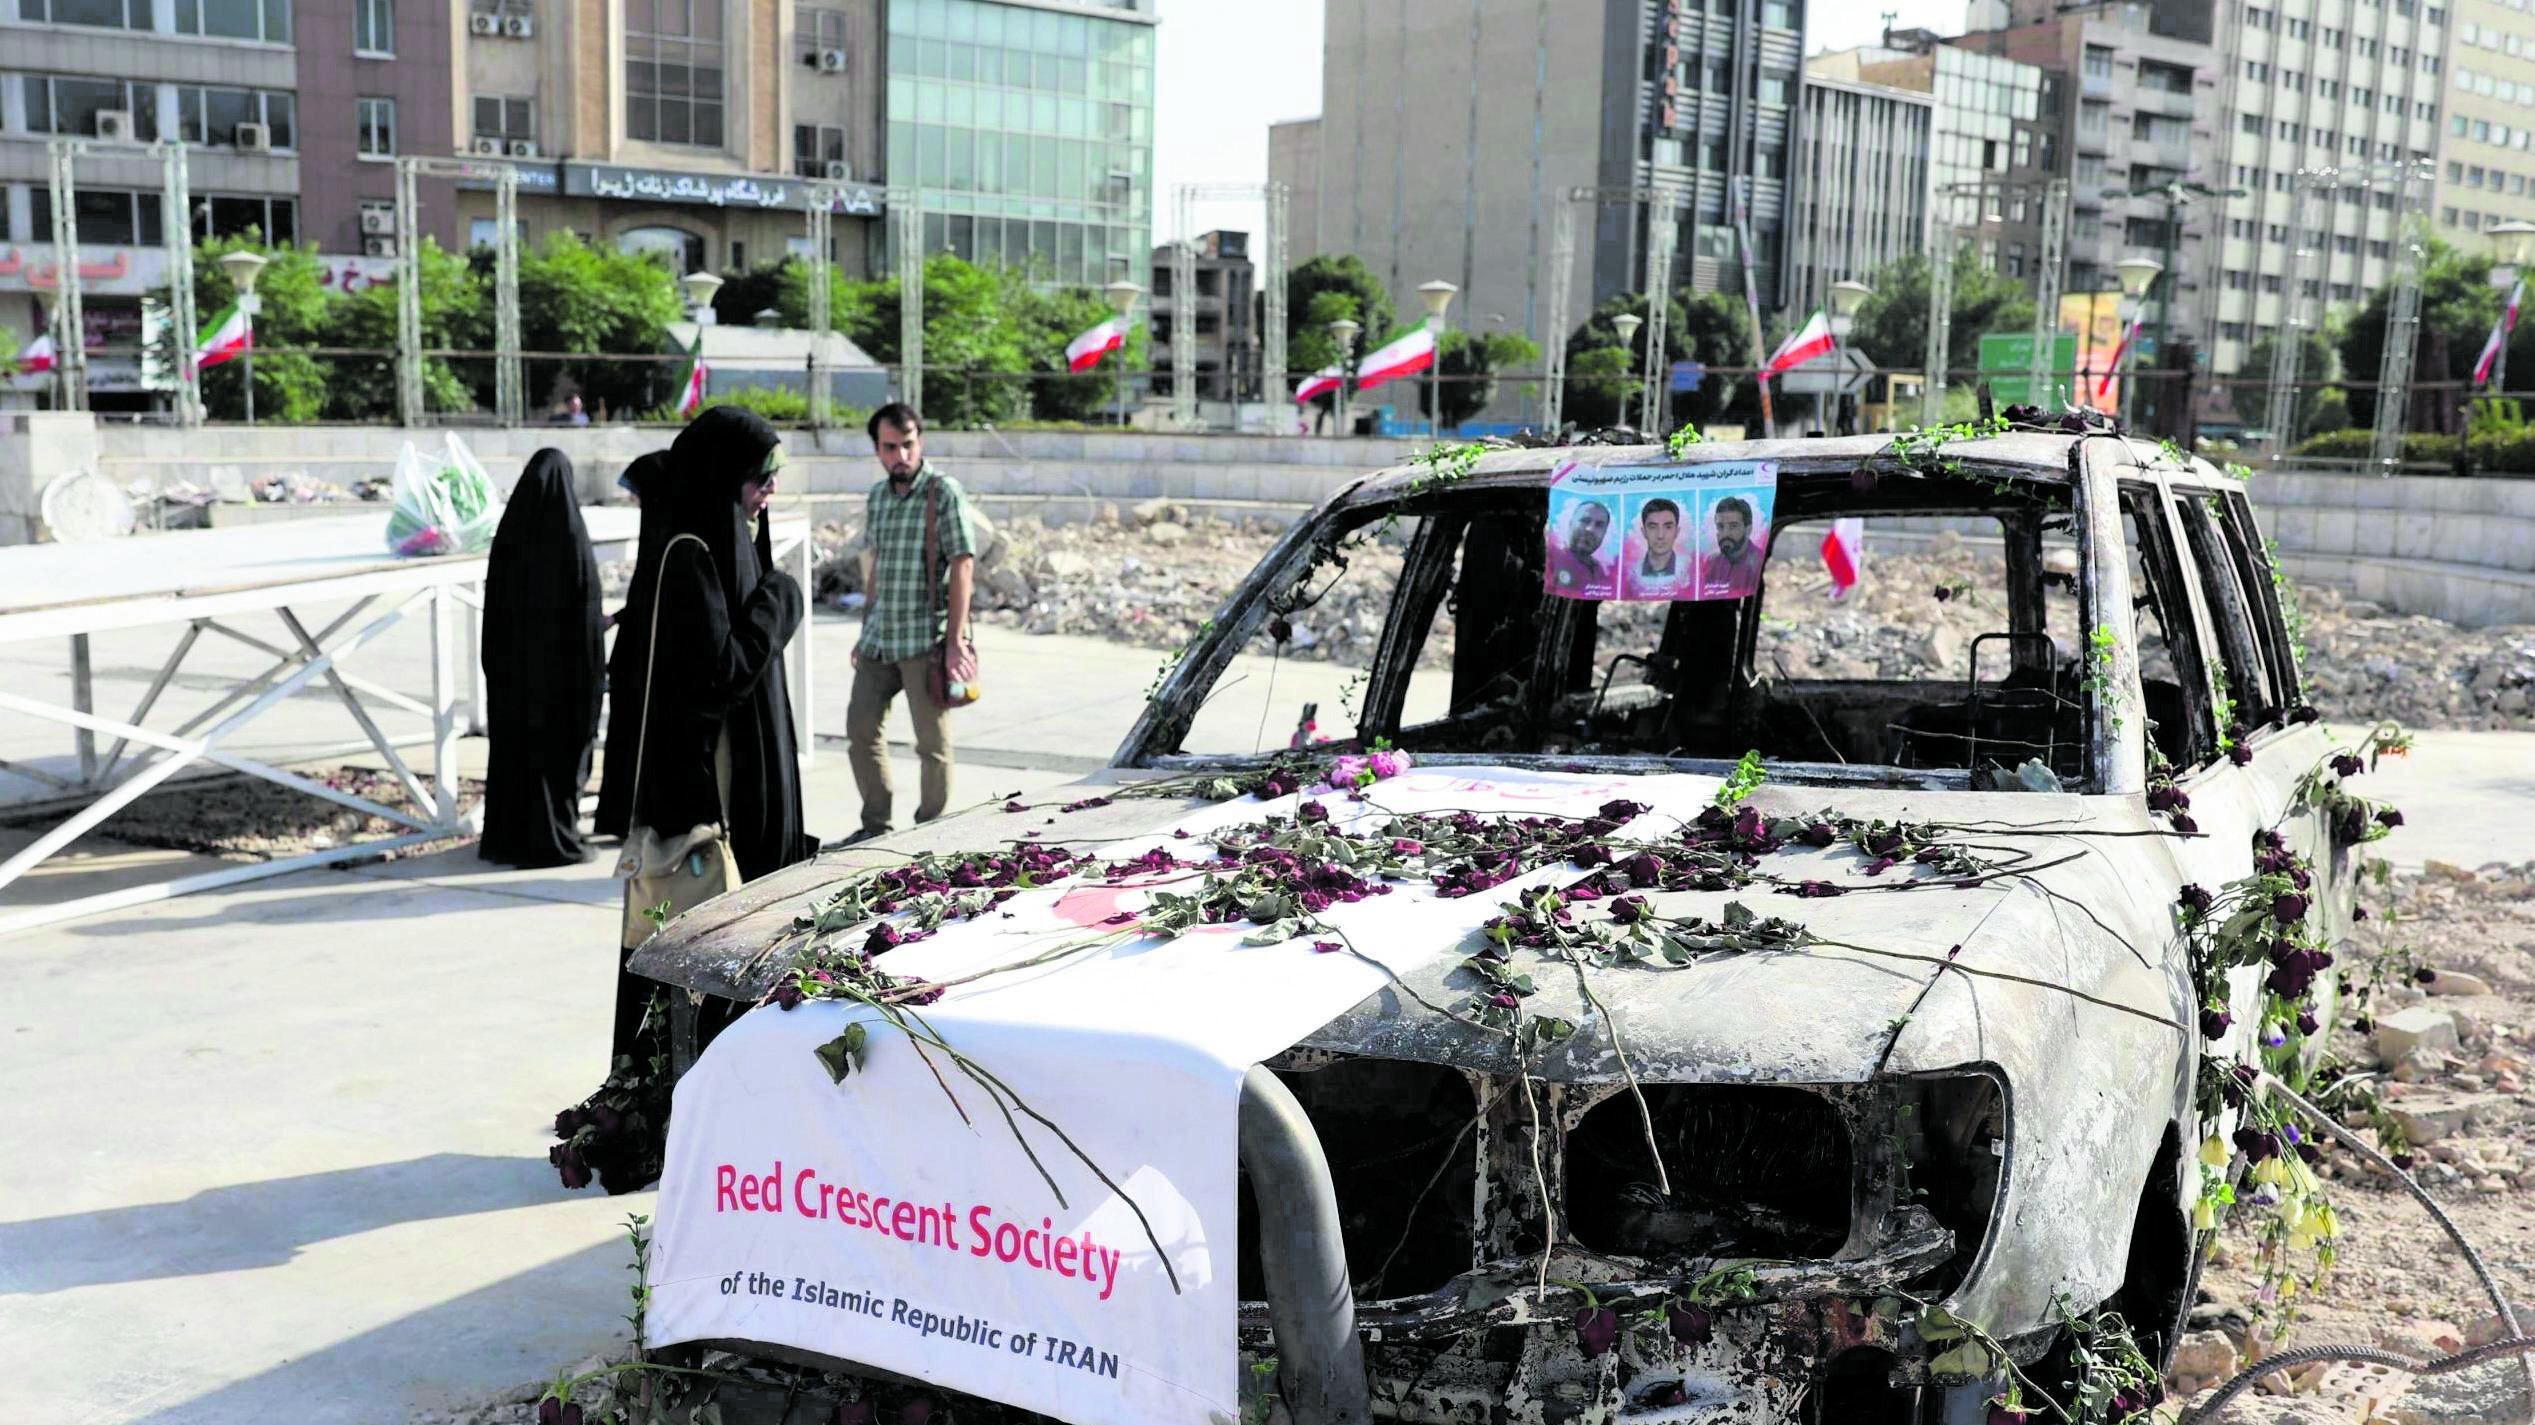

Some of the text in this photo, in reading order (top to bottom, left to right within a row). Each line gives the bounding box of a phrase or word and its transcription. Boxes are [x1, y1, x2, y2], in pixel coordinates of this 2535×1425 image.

[724, 179, 786, 206] فروشگاه
[716, 1161, 1121, 1301] Red Crescent Society
[720, 1270, 1119, 1380] of the Islamic Republic of IRAN
